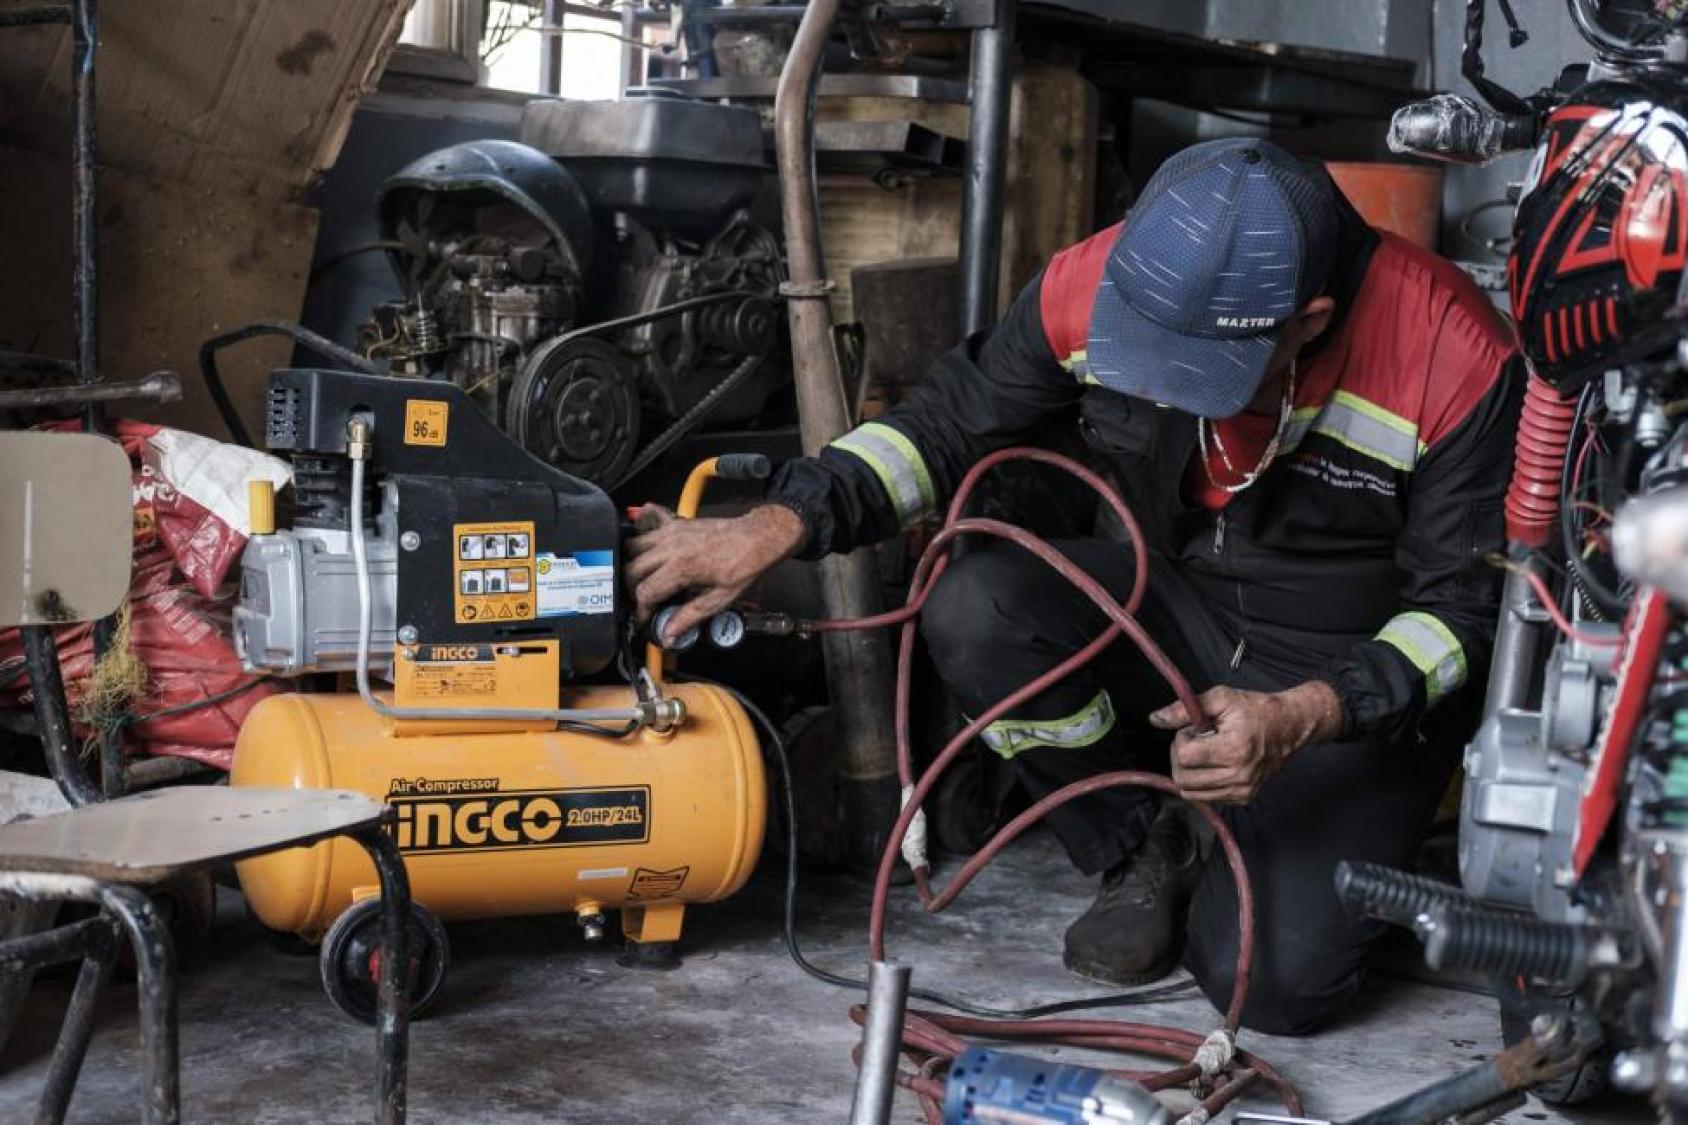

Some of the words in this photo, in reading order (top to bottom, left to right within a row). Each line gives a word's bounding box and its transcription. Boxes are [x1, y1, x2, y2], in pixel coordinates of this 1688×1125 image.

[413, 420, 429, 439] 96
[391, 780, 411, 793] Air
[415, 778, 499, 793] Compressor
[568, 806, 642, 826] 2.0HP/24L
